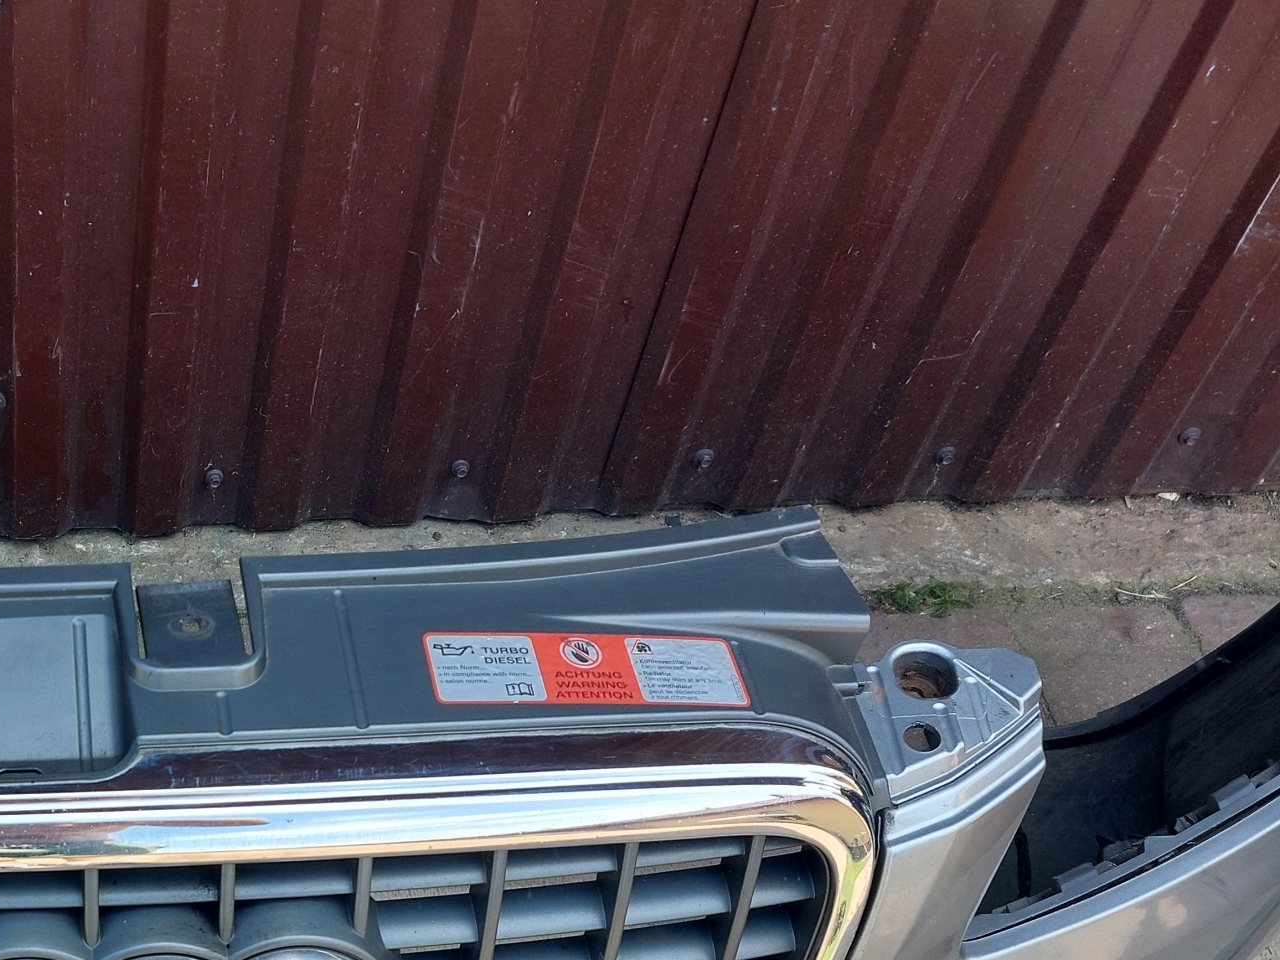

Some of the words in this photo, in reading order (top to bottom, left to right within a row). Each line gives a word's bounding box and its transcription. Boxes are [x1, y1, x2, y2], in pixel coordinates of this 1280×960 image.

[481, 646, 529, 655] TURBO
[484, 656, 532, 665] DIESEL
[555, 670, 623, 679] ACHTUNG
[556, 680, 627, 689] WARNING
[556, 690, 634, 699] ATTENTION
